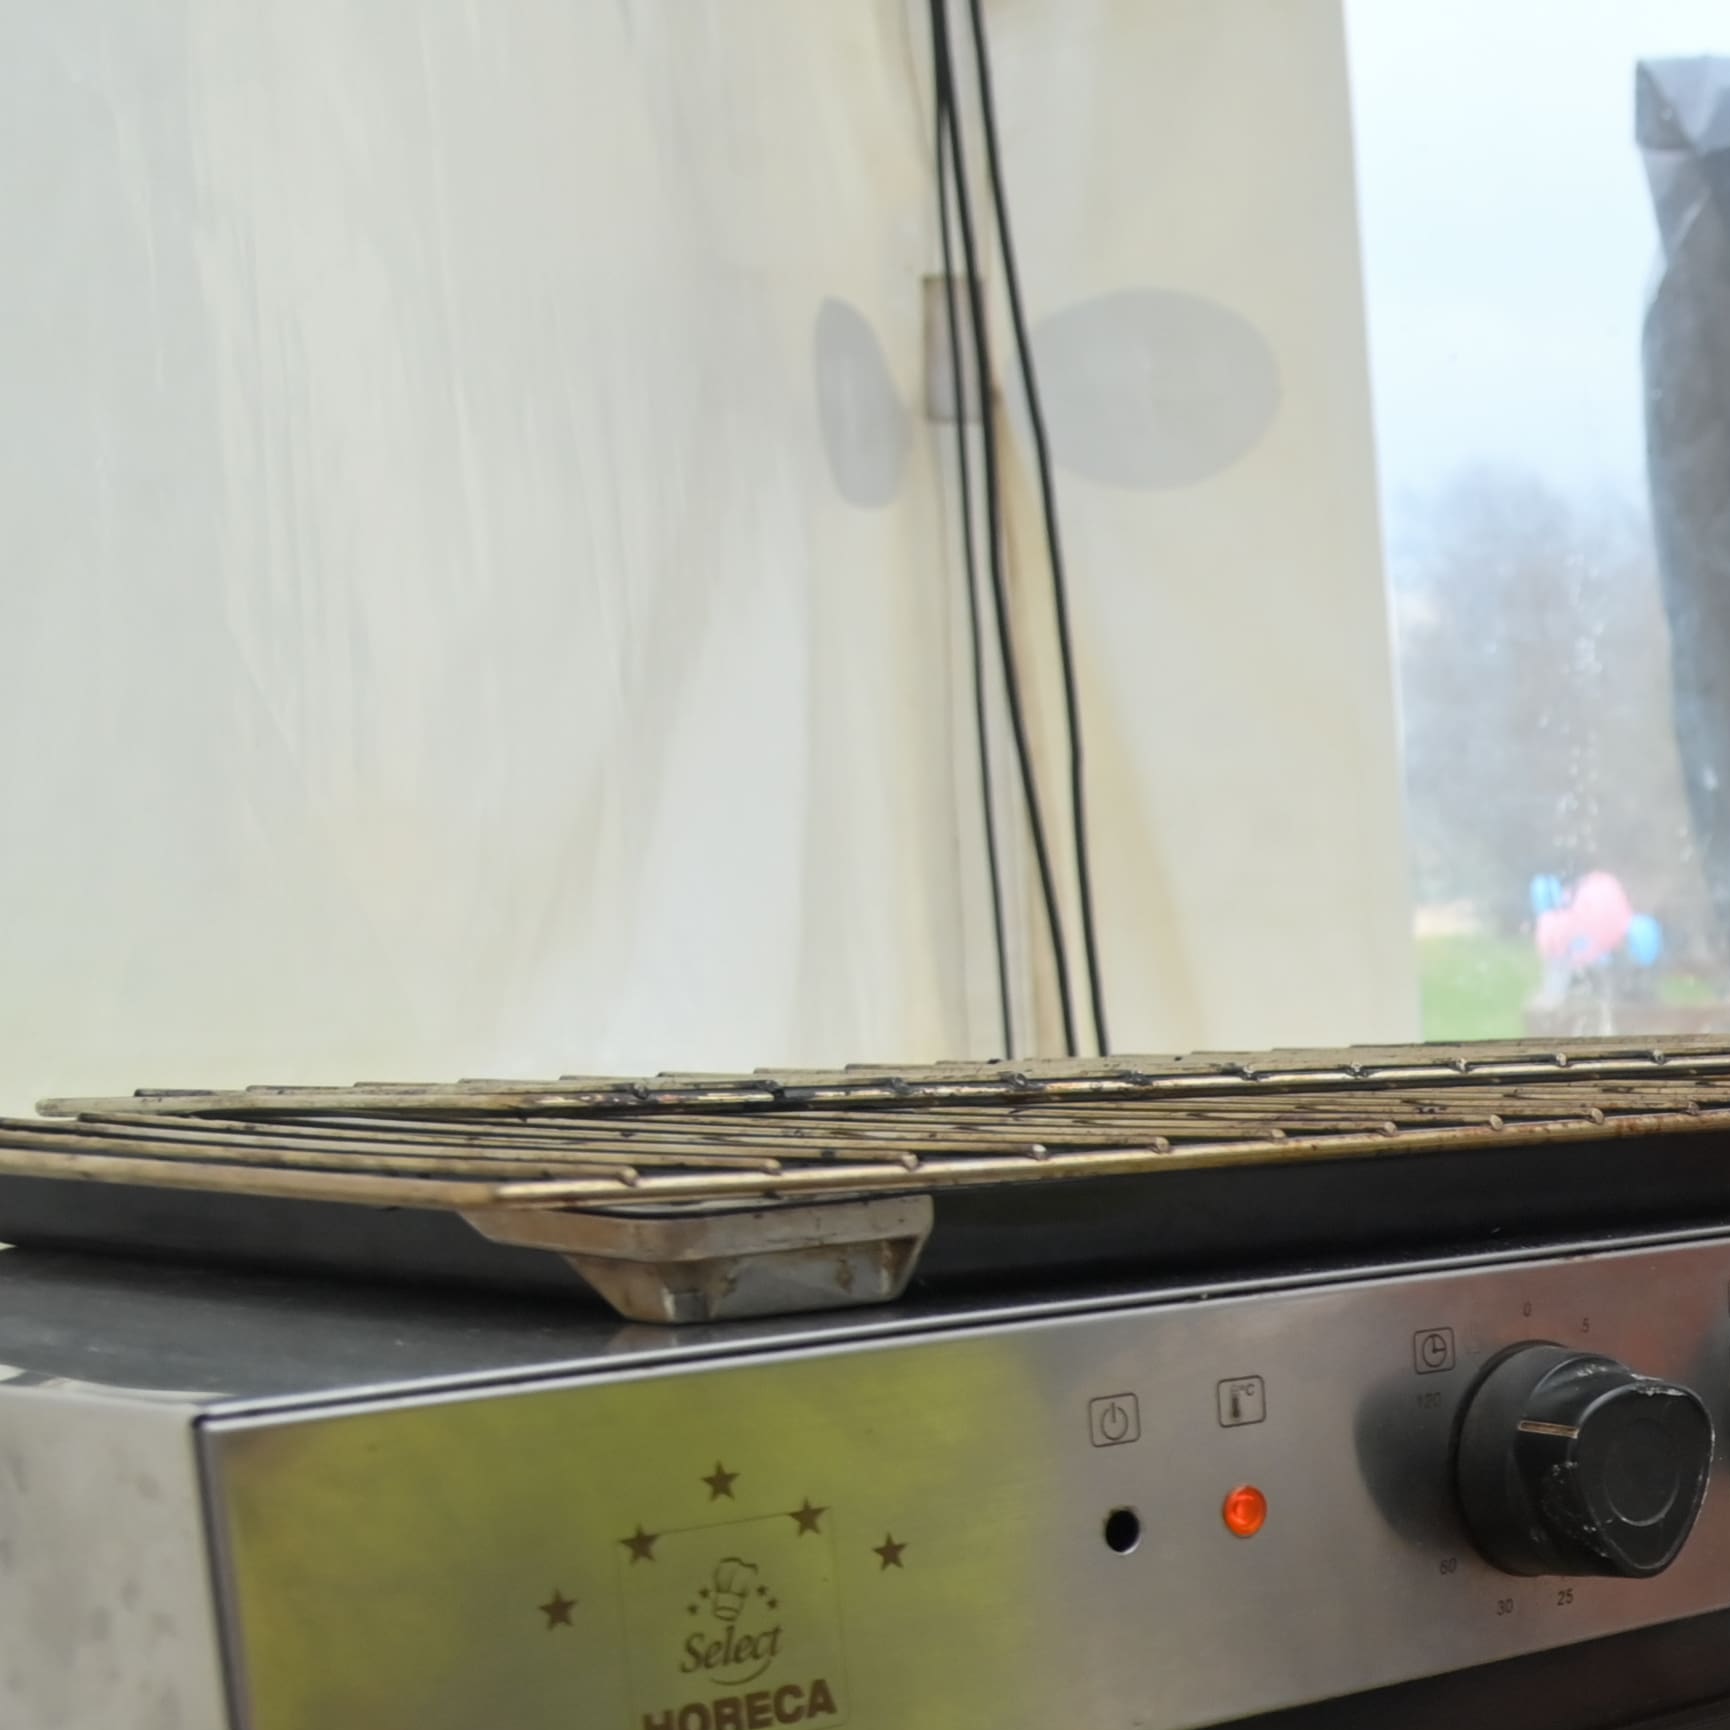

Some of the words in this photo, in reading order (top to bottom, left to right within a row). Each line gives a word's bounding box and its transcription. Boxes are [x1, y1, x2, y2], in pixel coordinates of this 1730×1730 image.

[1522, 1301, 1532, 1317] 0
[1582, 1317, 1590, 1333] 5
[1439, 1558, 1457, 1575] 60
[1557, 1588, 1574, 1606] 25
[1496, 1598, 1514, 1616] 30
[680, 1624, 783, 1674] Select
